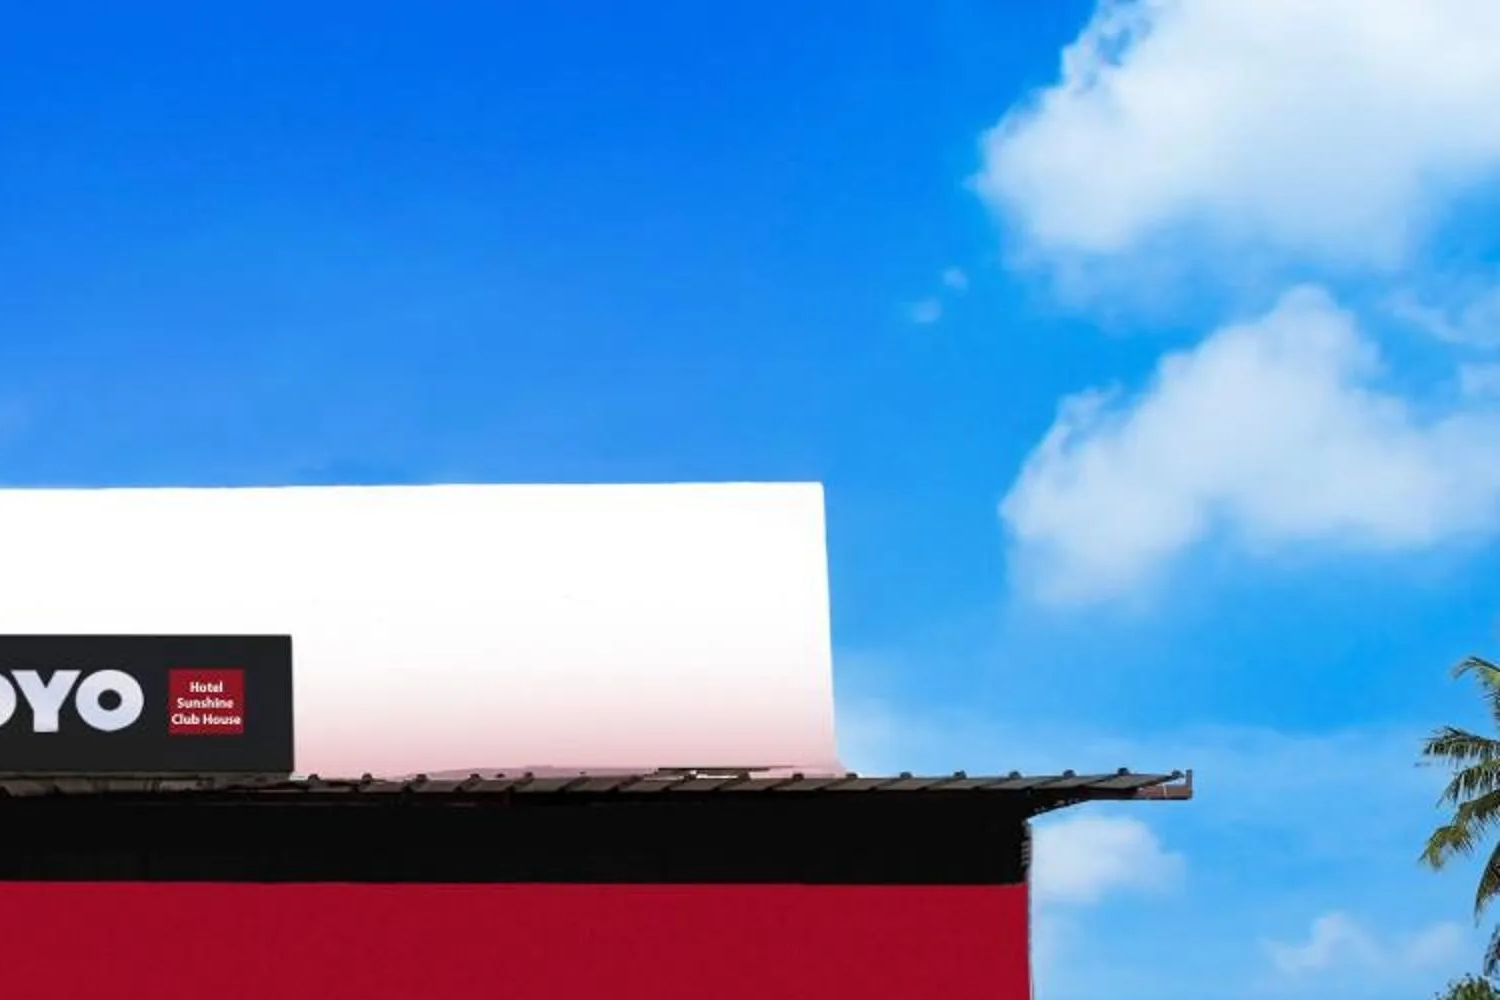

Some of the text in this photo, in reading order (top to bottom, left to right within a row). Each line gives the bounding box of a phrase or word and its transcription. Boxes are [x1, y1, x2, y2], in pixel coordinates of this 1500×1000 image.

[189, 680, 223, 693] Hotel
[177, 696, 234, 709] Sunshine
[171, 713, 242, 725] Club House
